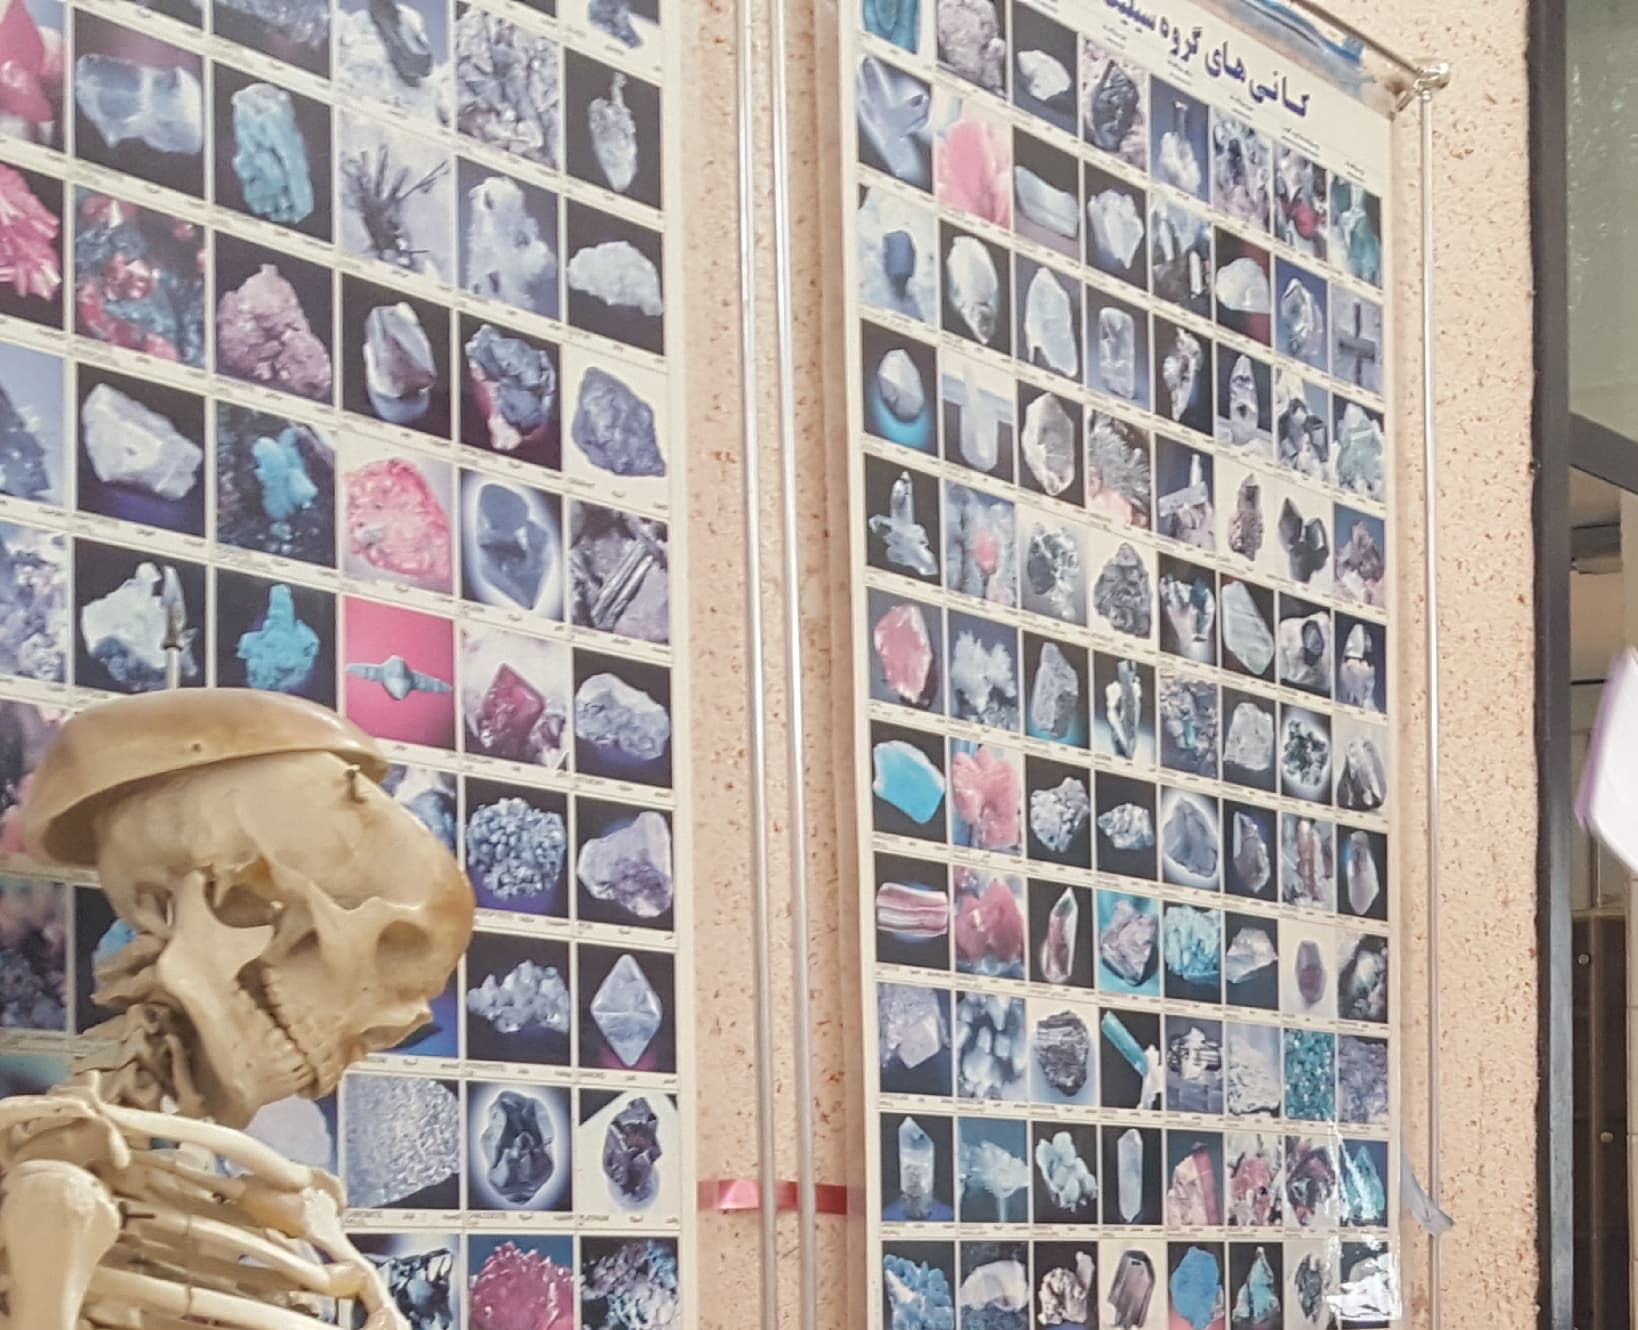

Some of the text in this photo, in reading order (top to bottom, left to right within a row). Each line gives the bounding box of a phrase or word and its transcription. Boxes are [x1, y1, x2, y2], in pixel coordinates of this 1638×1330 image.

[1159, 16, 1203, 62] گروه
[1204, 40, 1247, 83] های
[1249, 70, 1312, 118] کانی
